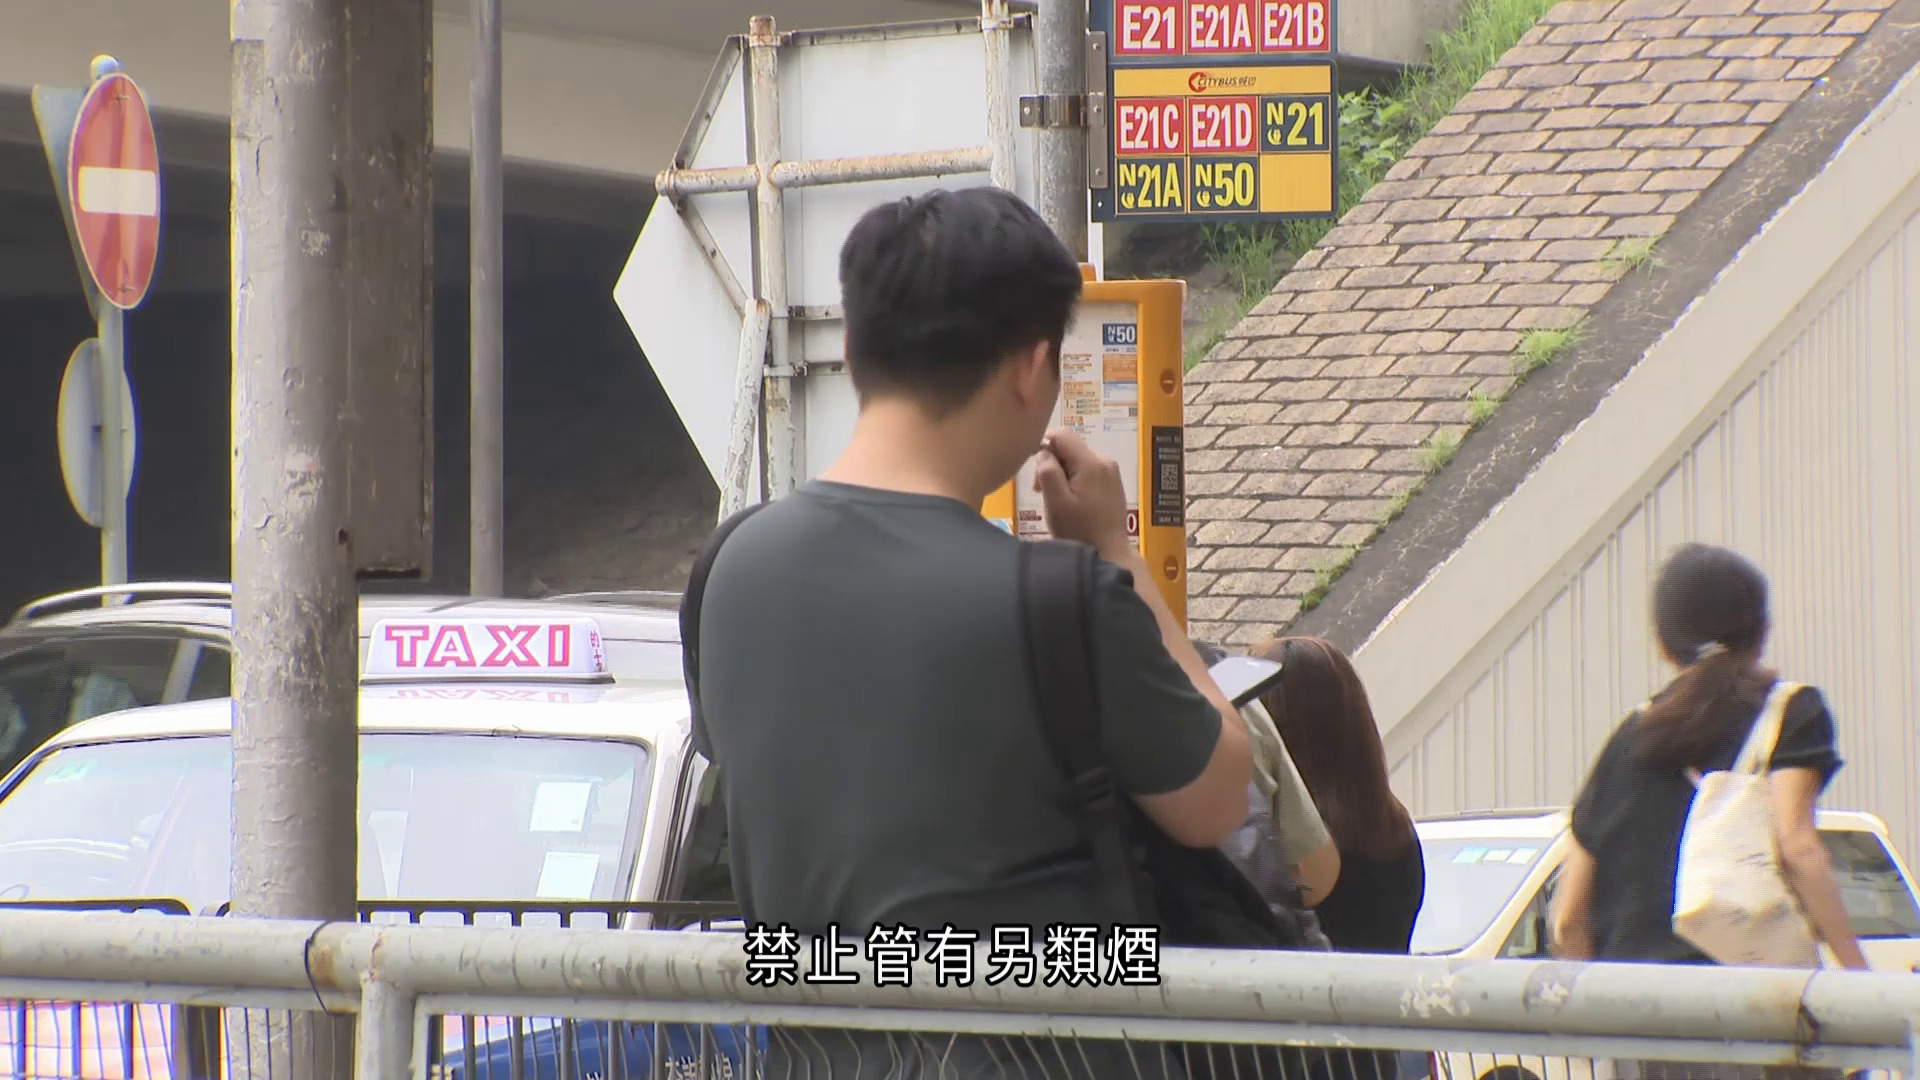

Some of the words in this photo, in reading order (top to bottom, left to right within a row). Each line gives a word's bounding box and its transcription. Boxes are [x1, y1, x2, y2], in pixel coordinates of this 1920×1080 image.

[1123, 5, 1175, 49] E21
[1190, 3, 1252, 48] E21A
[1264, 2, 1325, 47] E21B
[1120, 104, 1179, 149] E21C
[1192, 102, 1252, 148] E21D
[385, 624, 571, 668] TAXI
